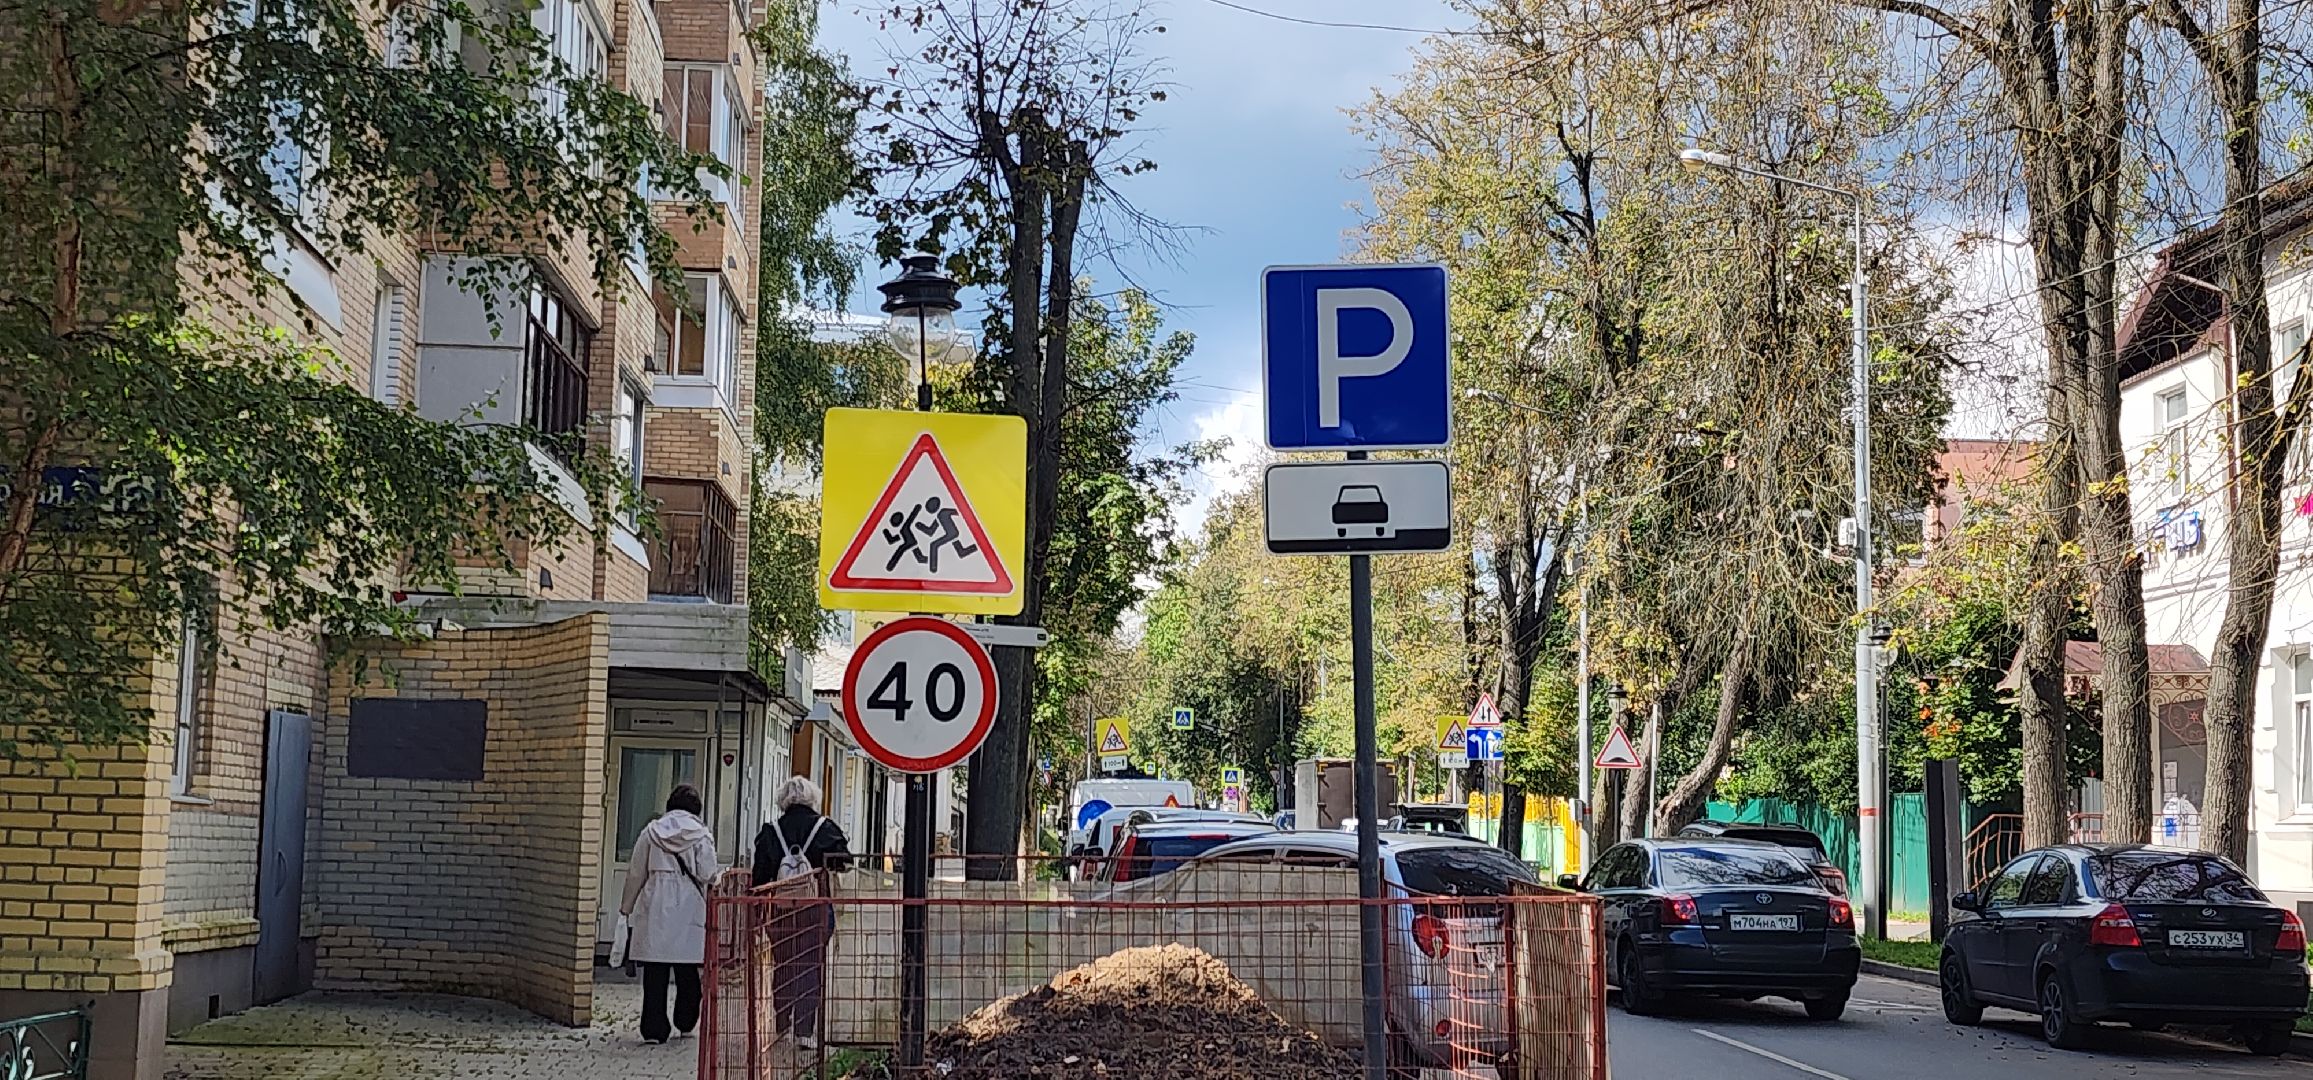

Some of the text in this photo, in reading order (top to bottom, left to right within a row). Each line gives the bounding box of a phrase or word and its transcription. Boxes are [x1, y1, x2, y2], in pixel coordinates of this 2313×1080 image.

[1317, 287, 1414, 428] P
[866, 661, 966, 722] 40
[2226, 932, 2240, 942] 34
